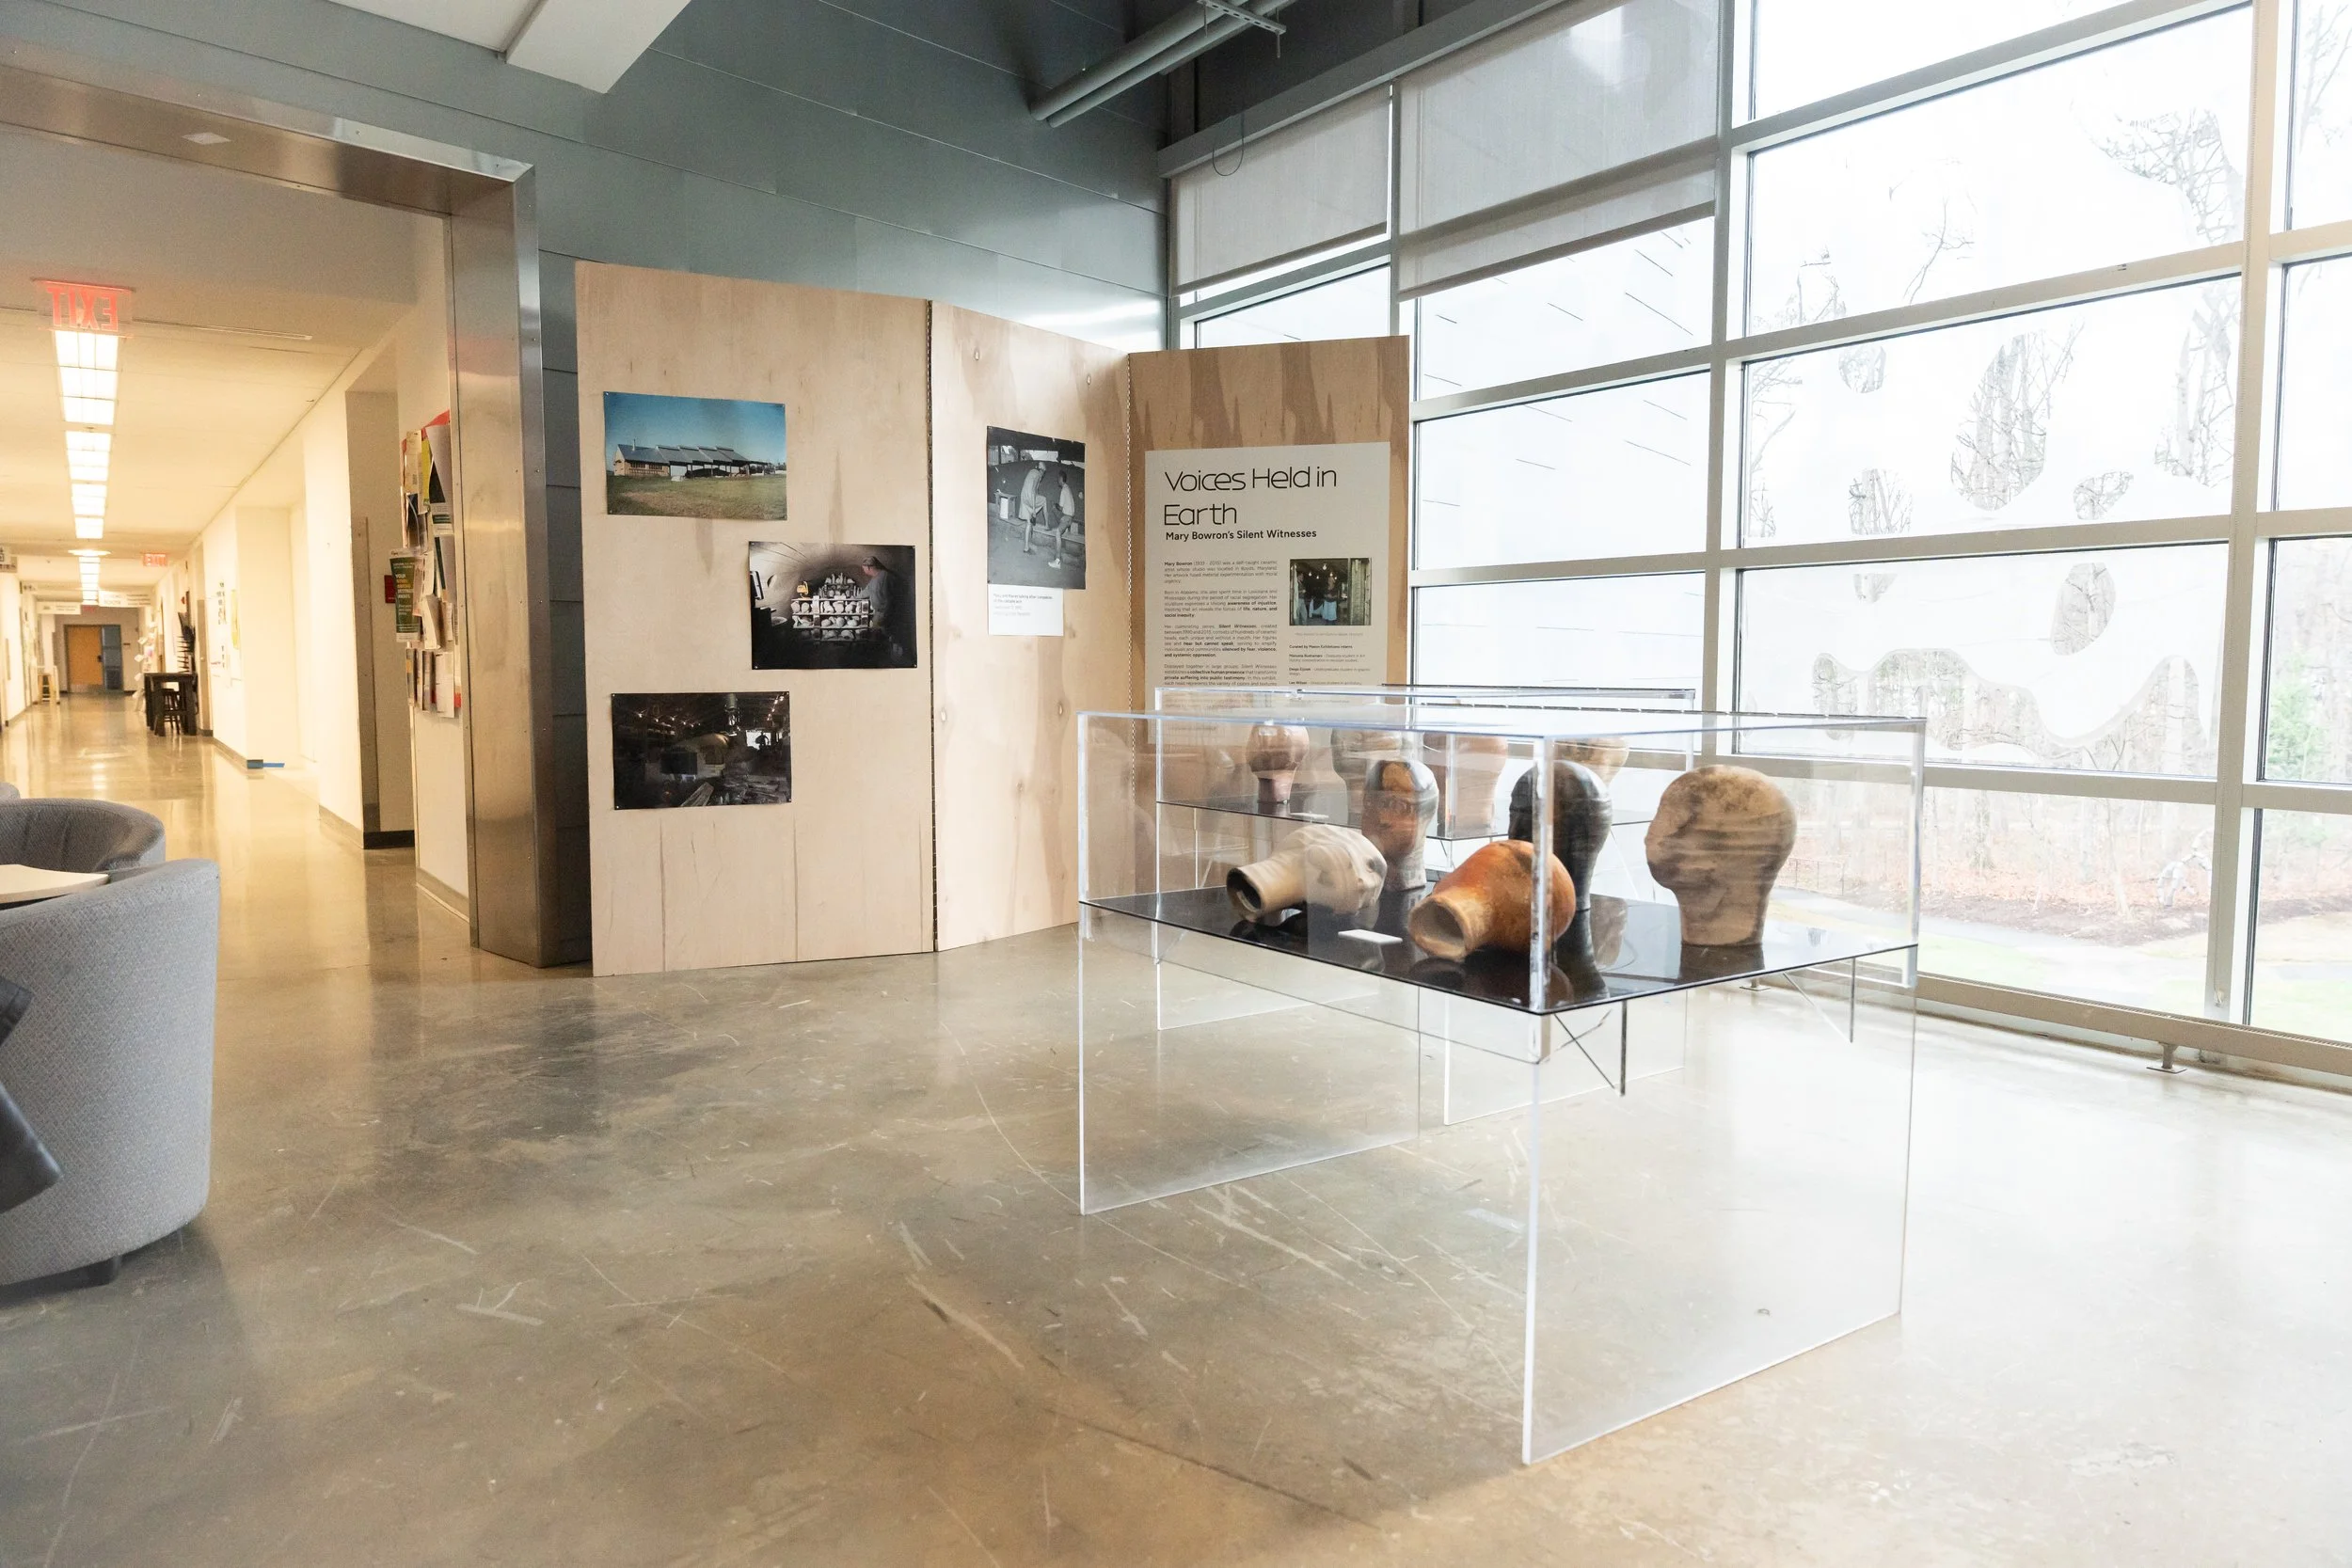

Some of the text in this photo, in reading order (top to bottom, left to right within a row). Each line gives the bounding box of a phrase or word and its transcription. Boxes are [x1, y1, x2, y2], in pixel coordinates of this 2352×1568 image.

[1165, 466, 1337, 492] Voices Held in
[1164, 503, 1237, 526] Earth
[1166, 529, 1317, 543] Mary Bowron's Silent Witnesses
